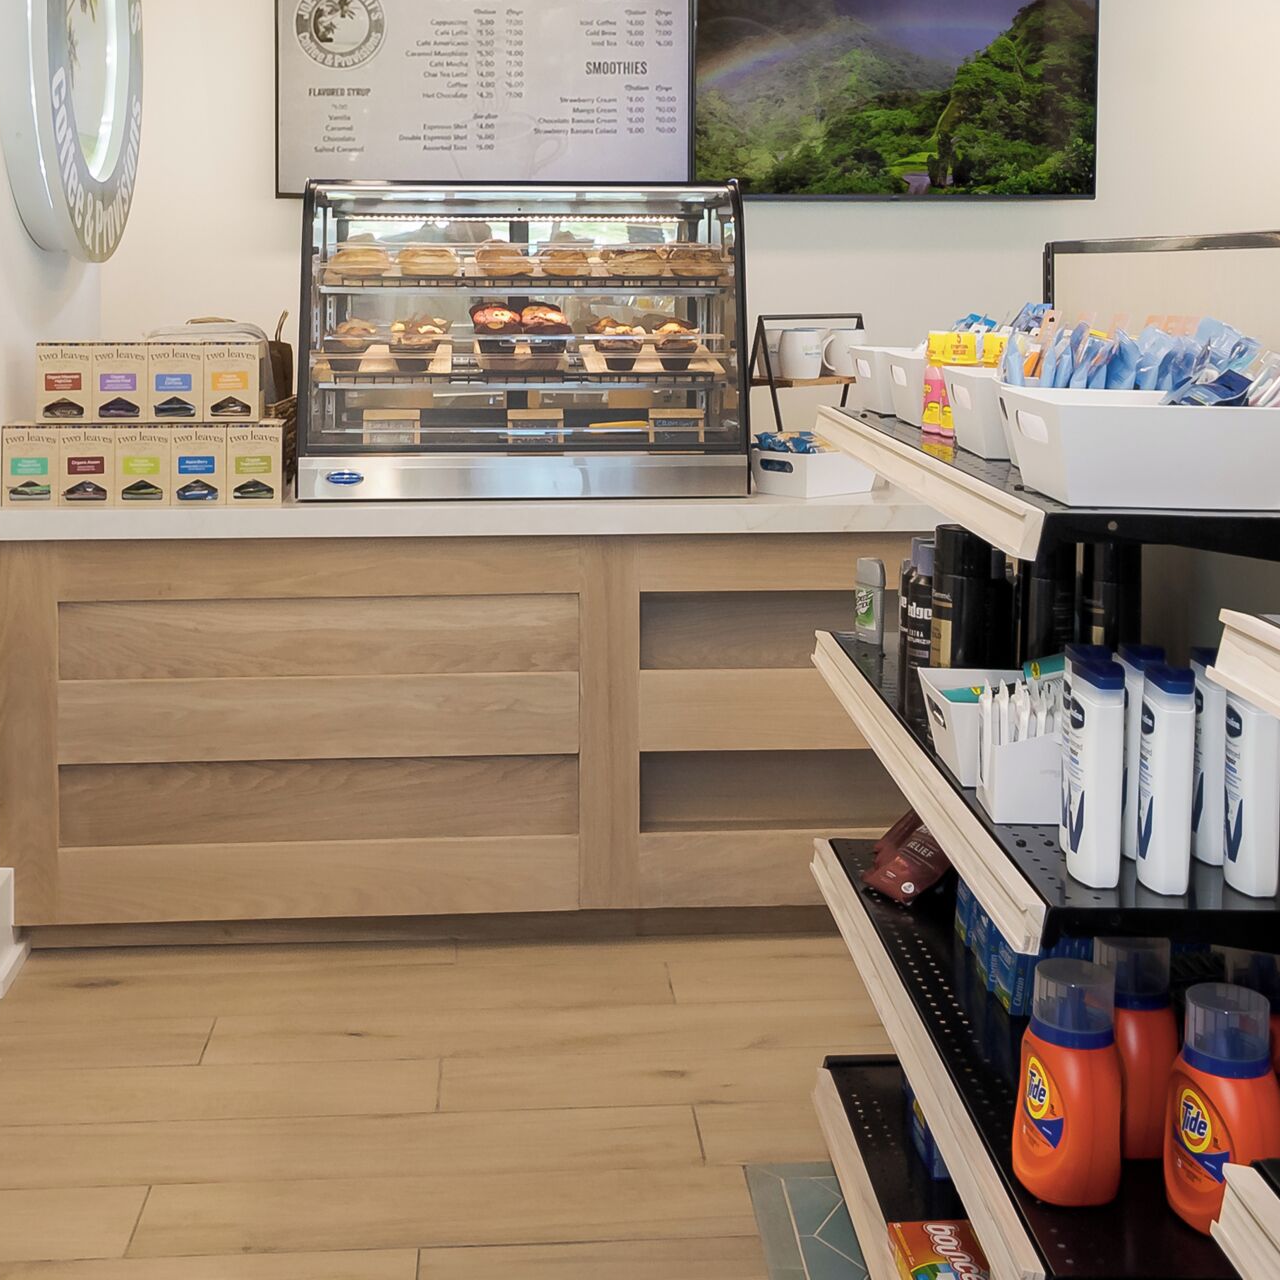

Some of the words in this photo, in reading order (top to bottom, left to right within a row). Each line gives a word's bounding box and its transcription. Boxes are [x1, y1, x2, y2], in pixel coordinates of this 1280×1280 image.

[298, 31, 326, 63] Coffee
[324, 55, 334, 67] &
[333, 31, 382, 68] Provisions
[585, 61, 648, 75] SMOOTHIES
[308, 88, 346, 97] FLAVORED
[51, 66, 85, 229] Coffee
[84, 191, 94, 251] &
[95, 94, 142, 255] Provisions
[39, 351, 58, 362] two
[60, 348, 90, 361] leaves
[94, 351, 114, 361] two
[116, 348, 145, 361] leaves
[150, 351, 170, 361] two
[171, 348, 201, 361] leaves
[206, 351, 226, 361] two
[227, 348, 257, 361] leaves
[5, 434, 25, 445] two
[27, 431, 57, 444] leaves
[61, 434, 81, 444] two
[83, 431, 113, 444] leaves
[117, 433, 137, 444] two
[139, 431, 169, 444] leaves
[173, 433, 193, 444] two
[194, 430, 224, 444] leaves
[229, 433, 249, 443] two
[250, 430, 280, 443] leaves
[1027, 1069, 1047, 1105] Tide
[1181, 1100, 1208, 1138] Tide
